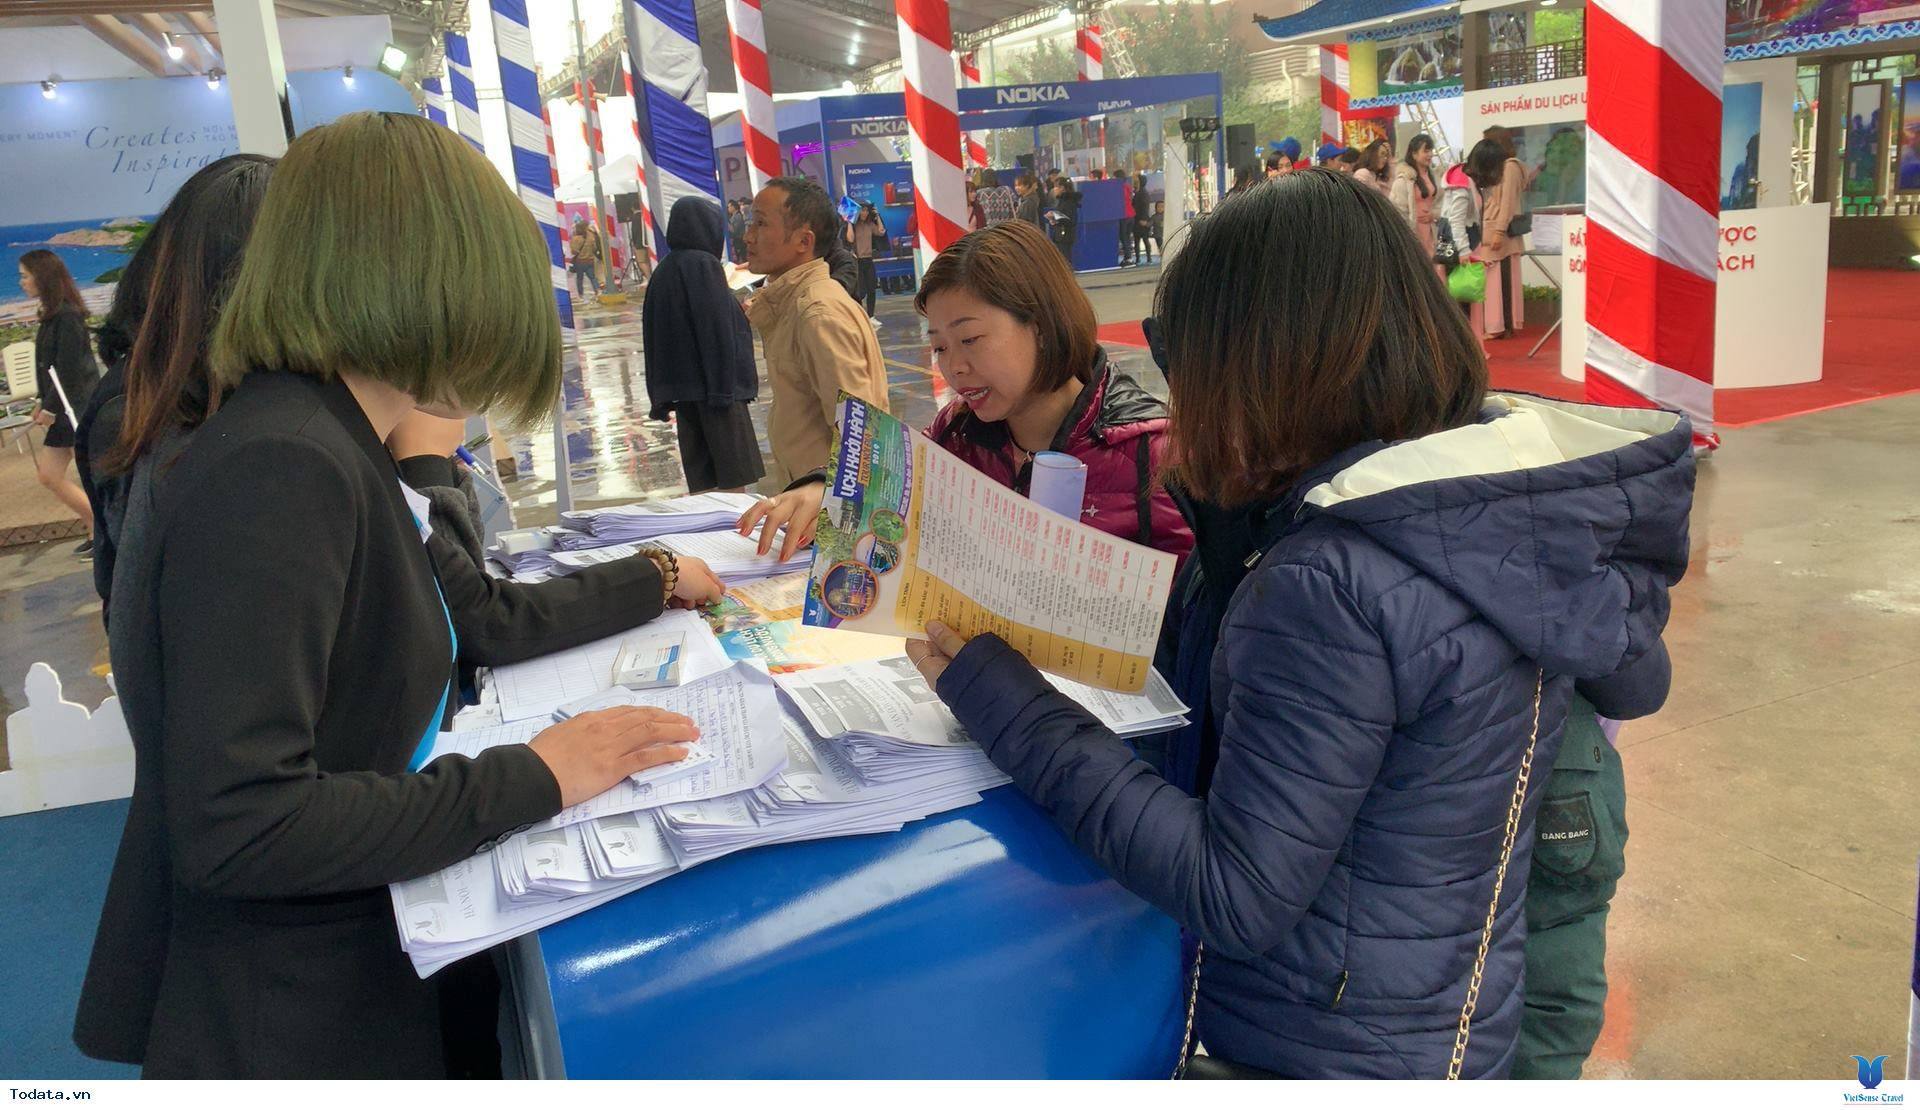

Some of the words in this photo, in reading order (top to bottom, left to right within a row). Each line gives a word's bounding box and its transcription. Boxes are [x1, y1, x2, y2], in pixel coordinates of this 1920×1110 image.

[997, 85, 1069, 104] NOKIA
[1535, 97, 1550, 109] DU
[1553, 94, 1577, 108] LỊCH
[27, 130, 77, 140] MOMENT
[86, 126, 197, 149] Creates
[851, 121, 908, 136] NOKIA
[112, 147, 228, 194] Inspirat
[1717, 226, 1757, 247] ỢC
[848, 401, 865, 440] HÀNH
[844, 438, 862, 469] KHỞI
[1541, 832, 1567, 840] BANG
[1568, 829, 1589, 839] BANG
